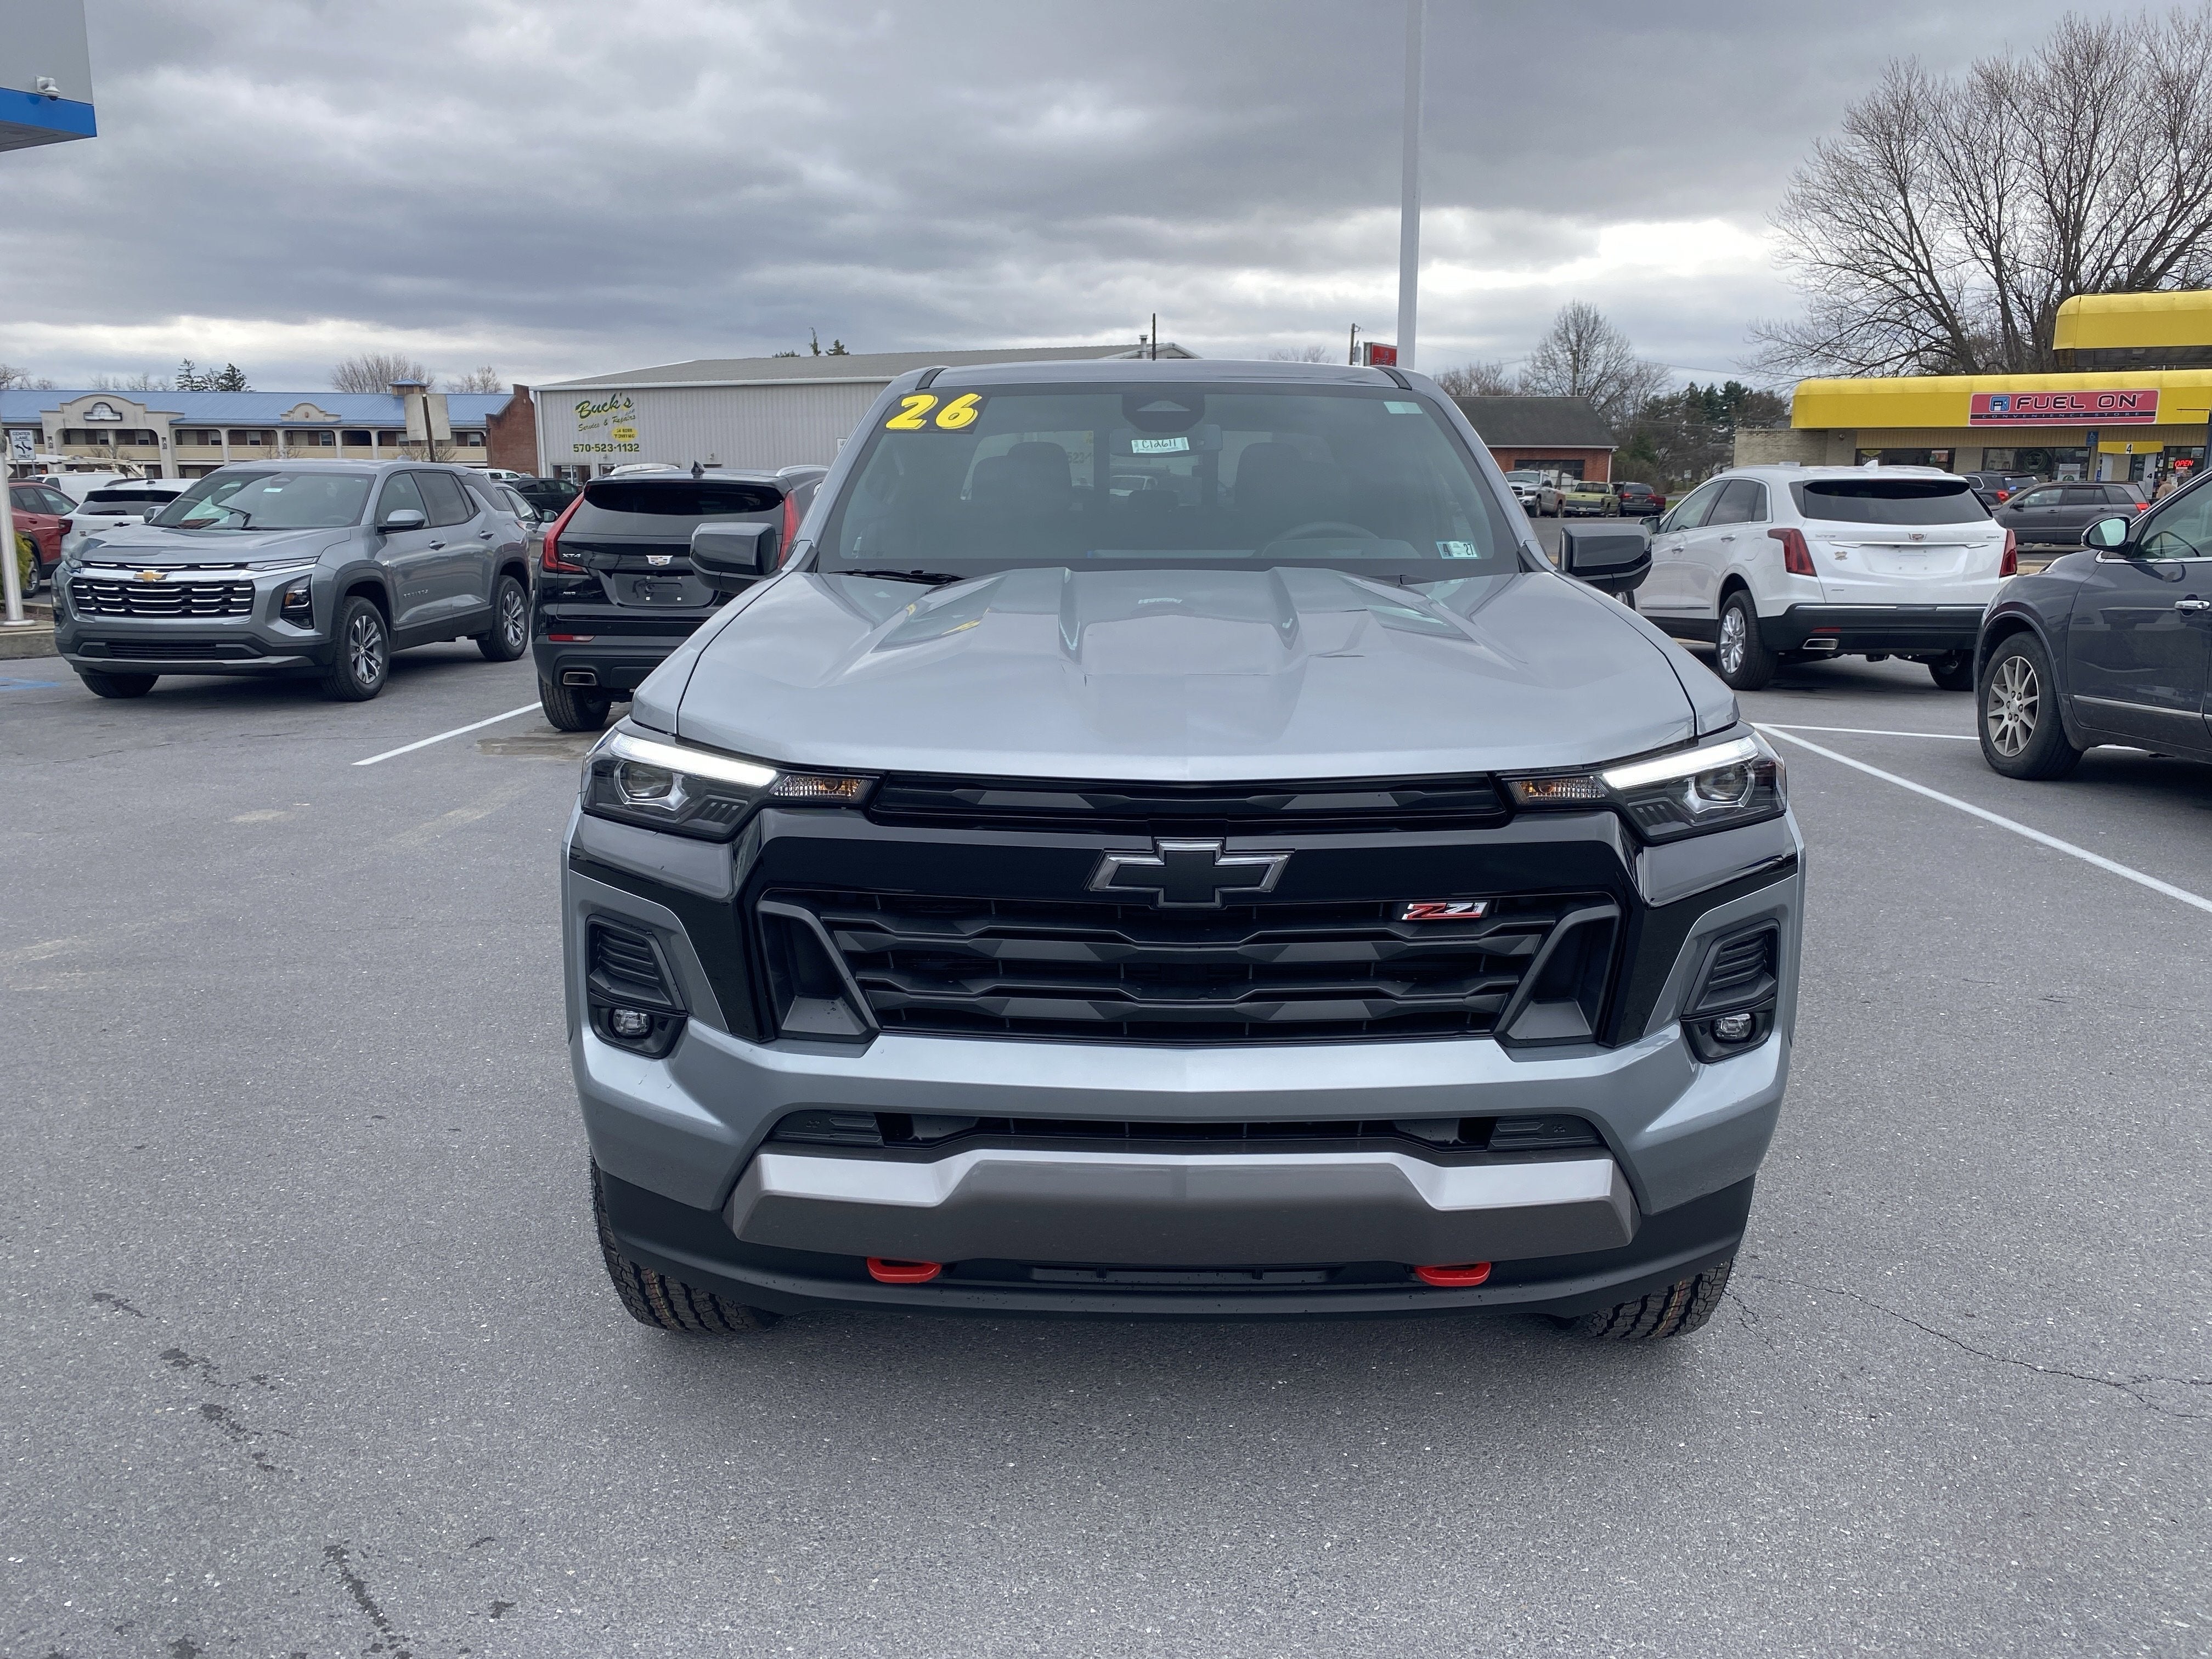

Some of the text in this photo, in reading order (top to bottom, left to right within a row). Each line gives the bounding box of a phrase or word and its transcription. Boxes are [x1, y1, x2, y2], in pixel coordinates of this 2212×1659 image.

[575, 392, 634, 419] Buck's
[2015, 393, 2138, 411] FUEL ON
[885, 393, 983, 430] 26
[612, 415, 636, 424] Repairs
[573, 443, 640, 453] 570-523-1132
[1142, 439, 1176, 448] C12611
[2126, 444, 2132, 454] 4
[1463, 543, 1474, 556] 27
[1402, 902, 1488, 920] Z71
